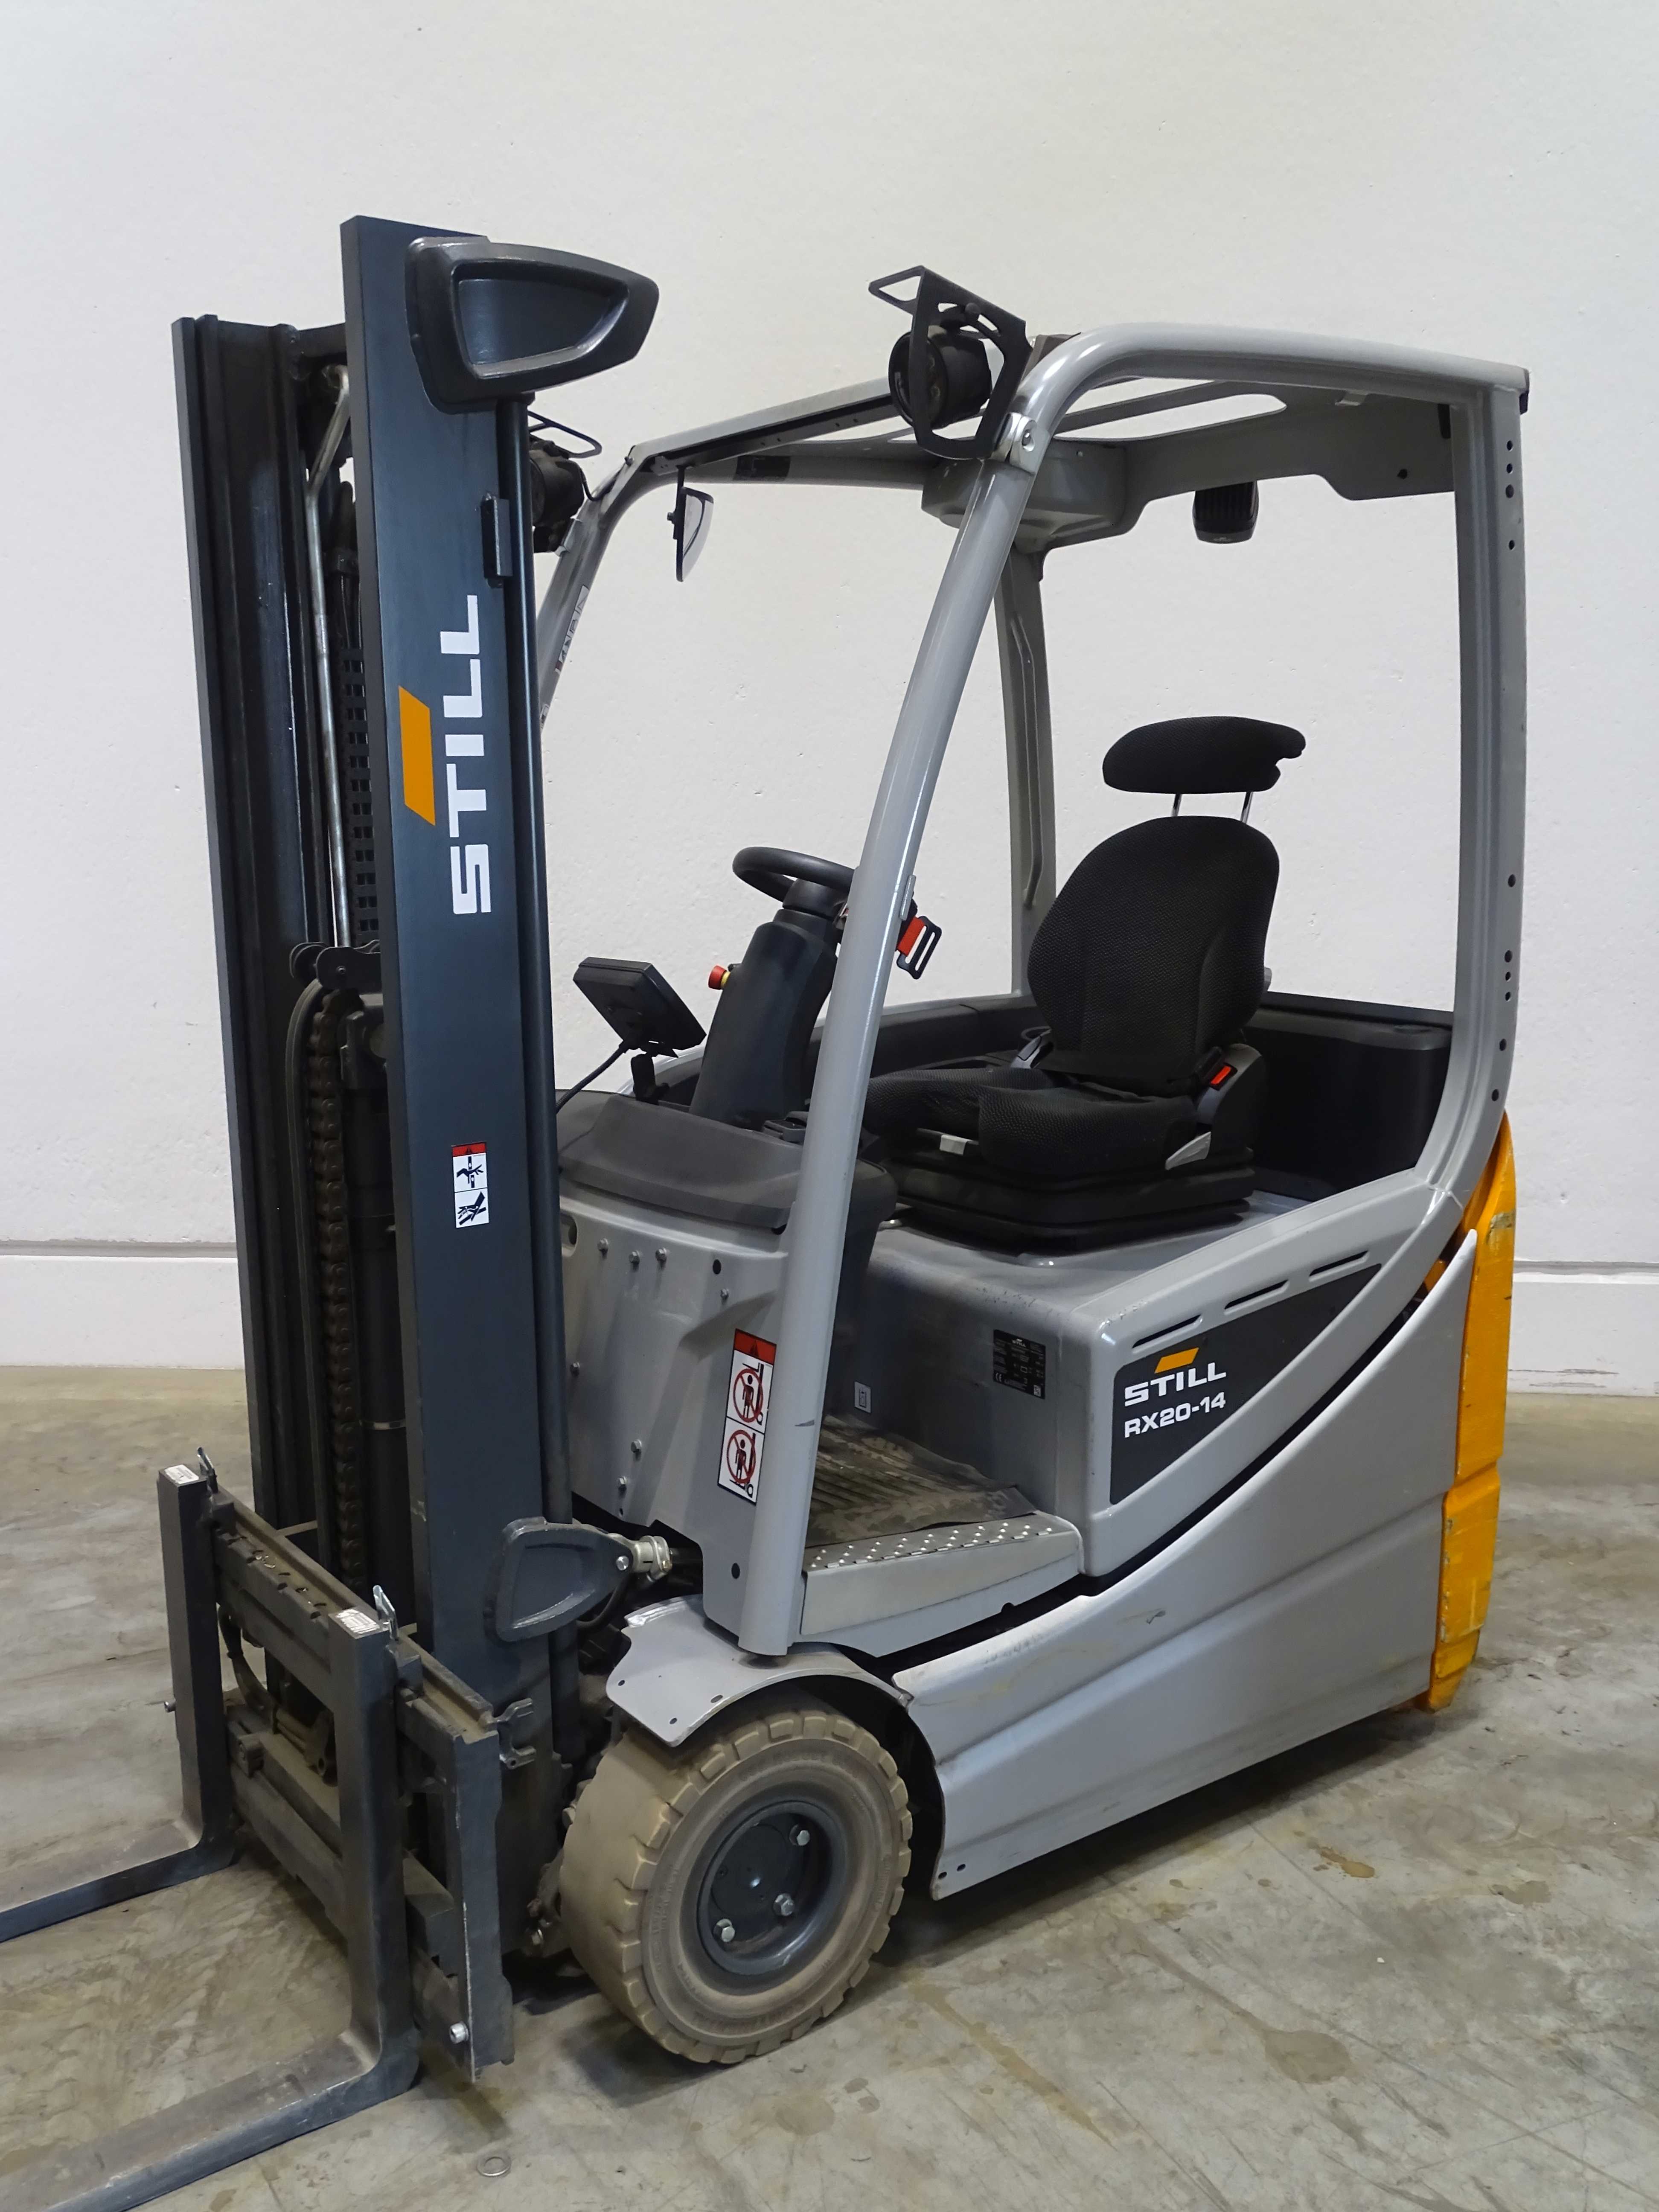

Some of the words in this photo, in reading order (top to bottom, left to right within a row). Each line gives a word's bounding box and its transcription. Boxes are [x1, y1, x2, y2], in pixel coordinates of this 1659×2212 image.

[440, 595, 492, 914] STILL
[1124, 1362, 1227, 1407] STILL
[1124, 1391, 1226, 1438] RX20-14
